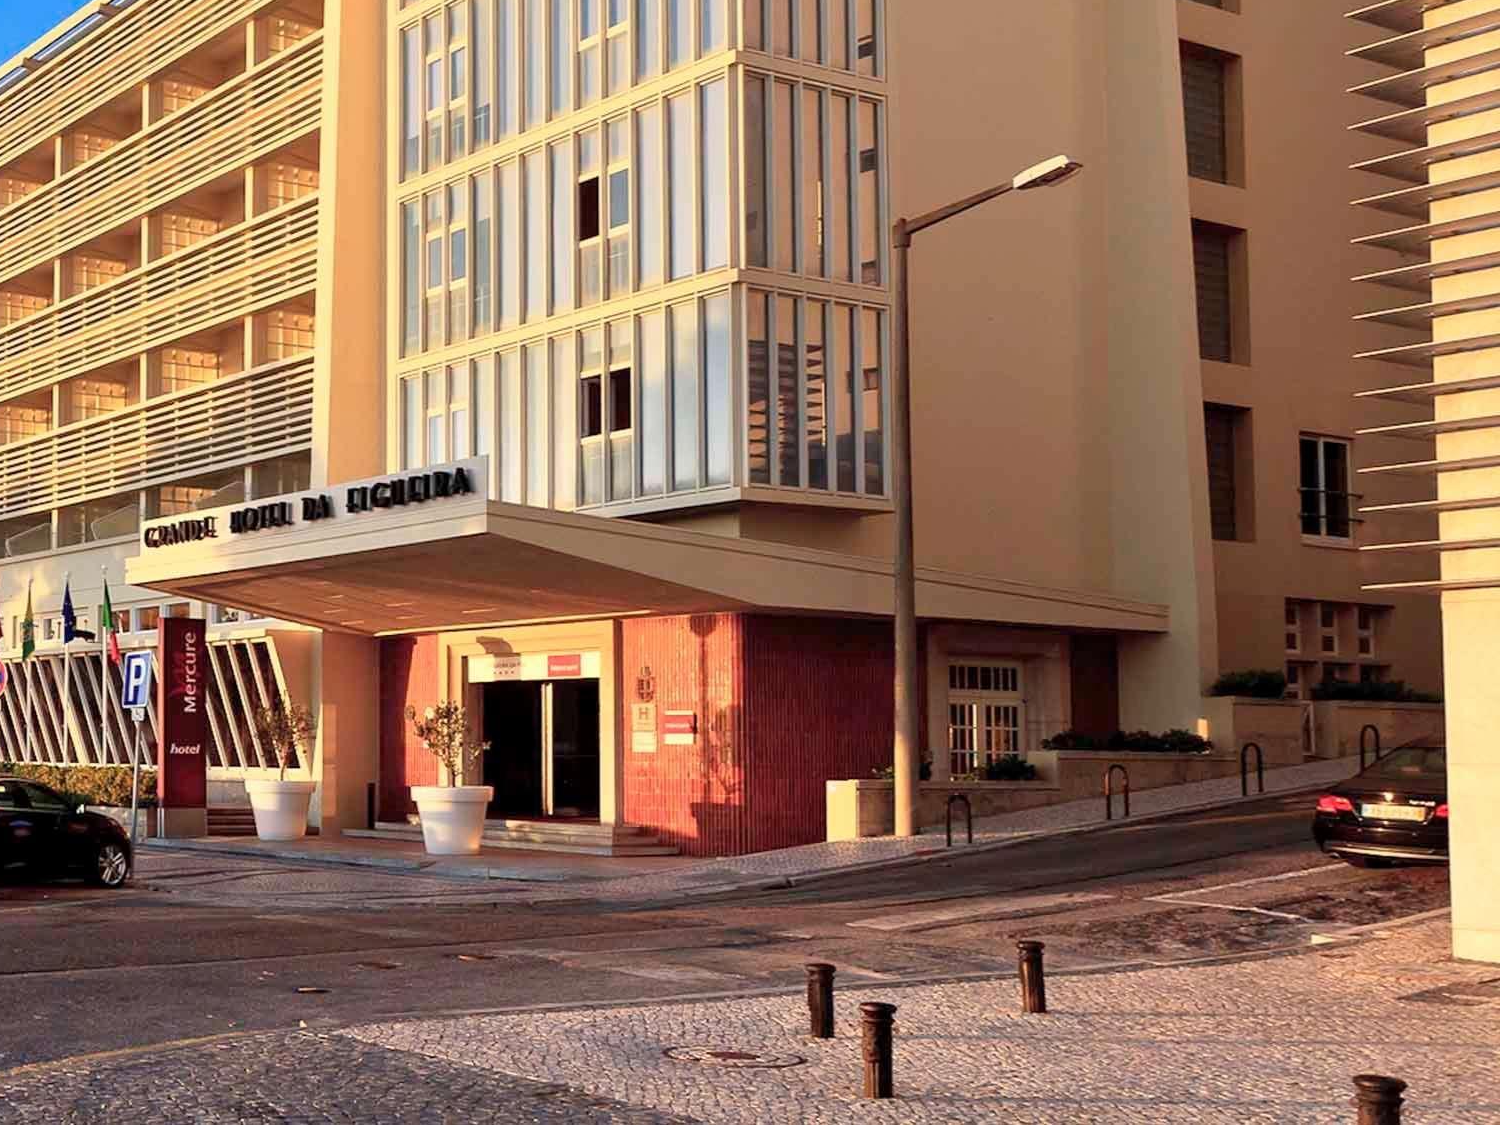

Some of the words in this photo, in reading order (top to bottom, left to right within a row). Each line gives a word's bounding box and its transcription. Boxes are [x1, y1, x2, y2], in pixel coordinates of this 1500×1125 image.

[144, 515, 219, 549] GRANDE
[229, 501, 295, 534] HOTEL
[301, 493, 335, 522] DA
[346, 466, 476, 514] FIGUEIRA
[128, 657, 146, 703] P
[183, 631, 197, 714] Mercure
[169, 742, 201, 755] hotel
